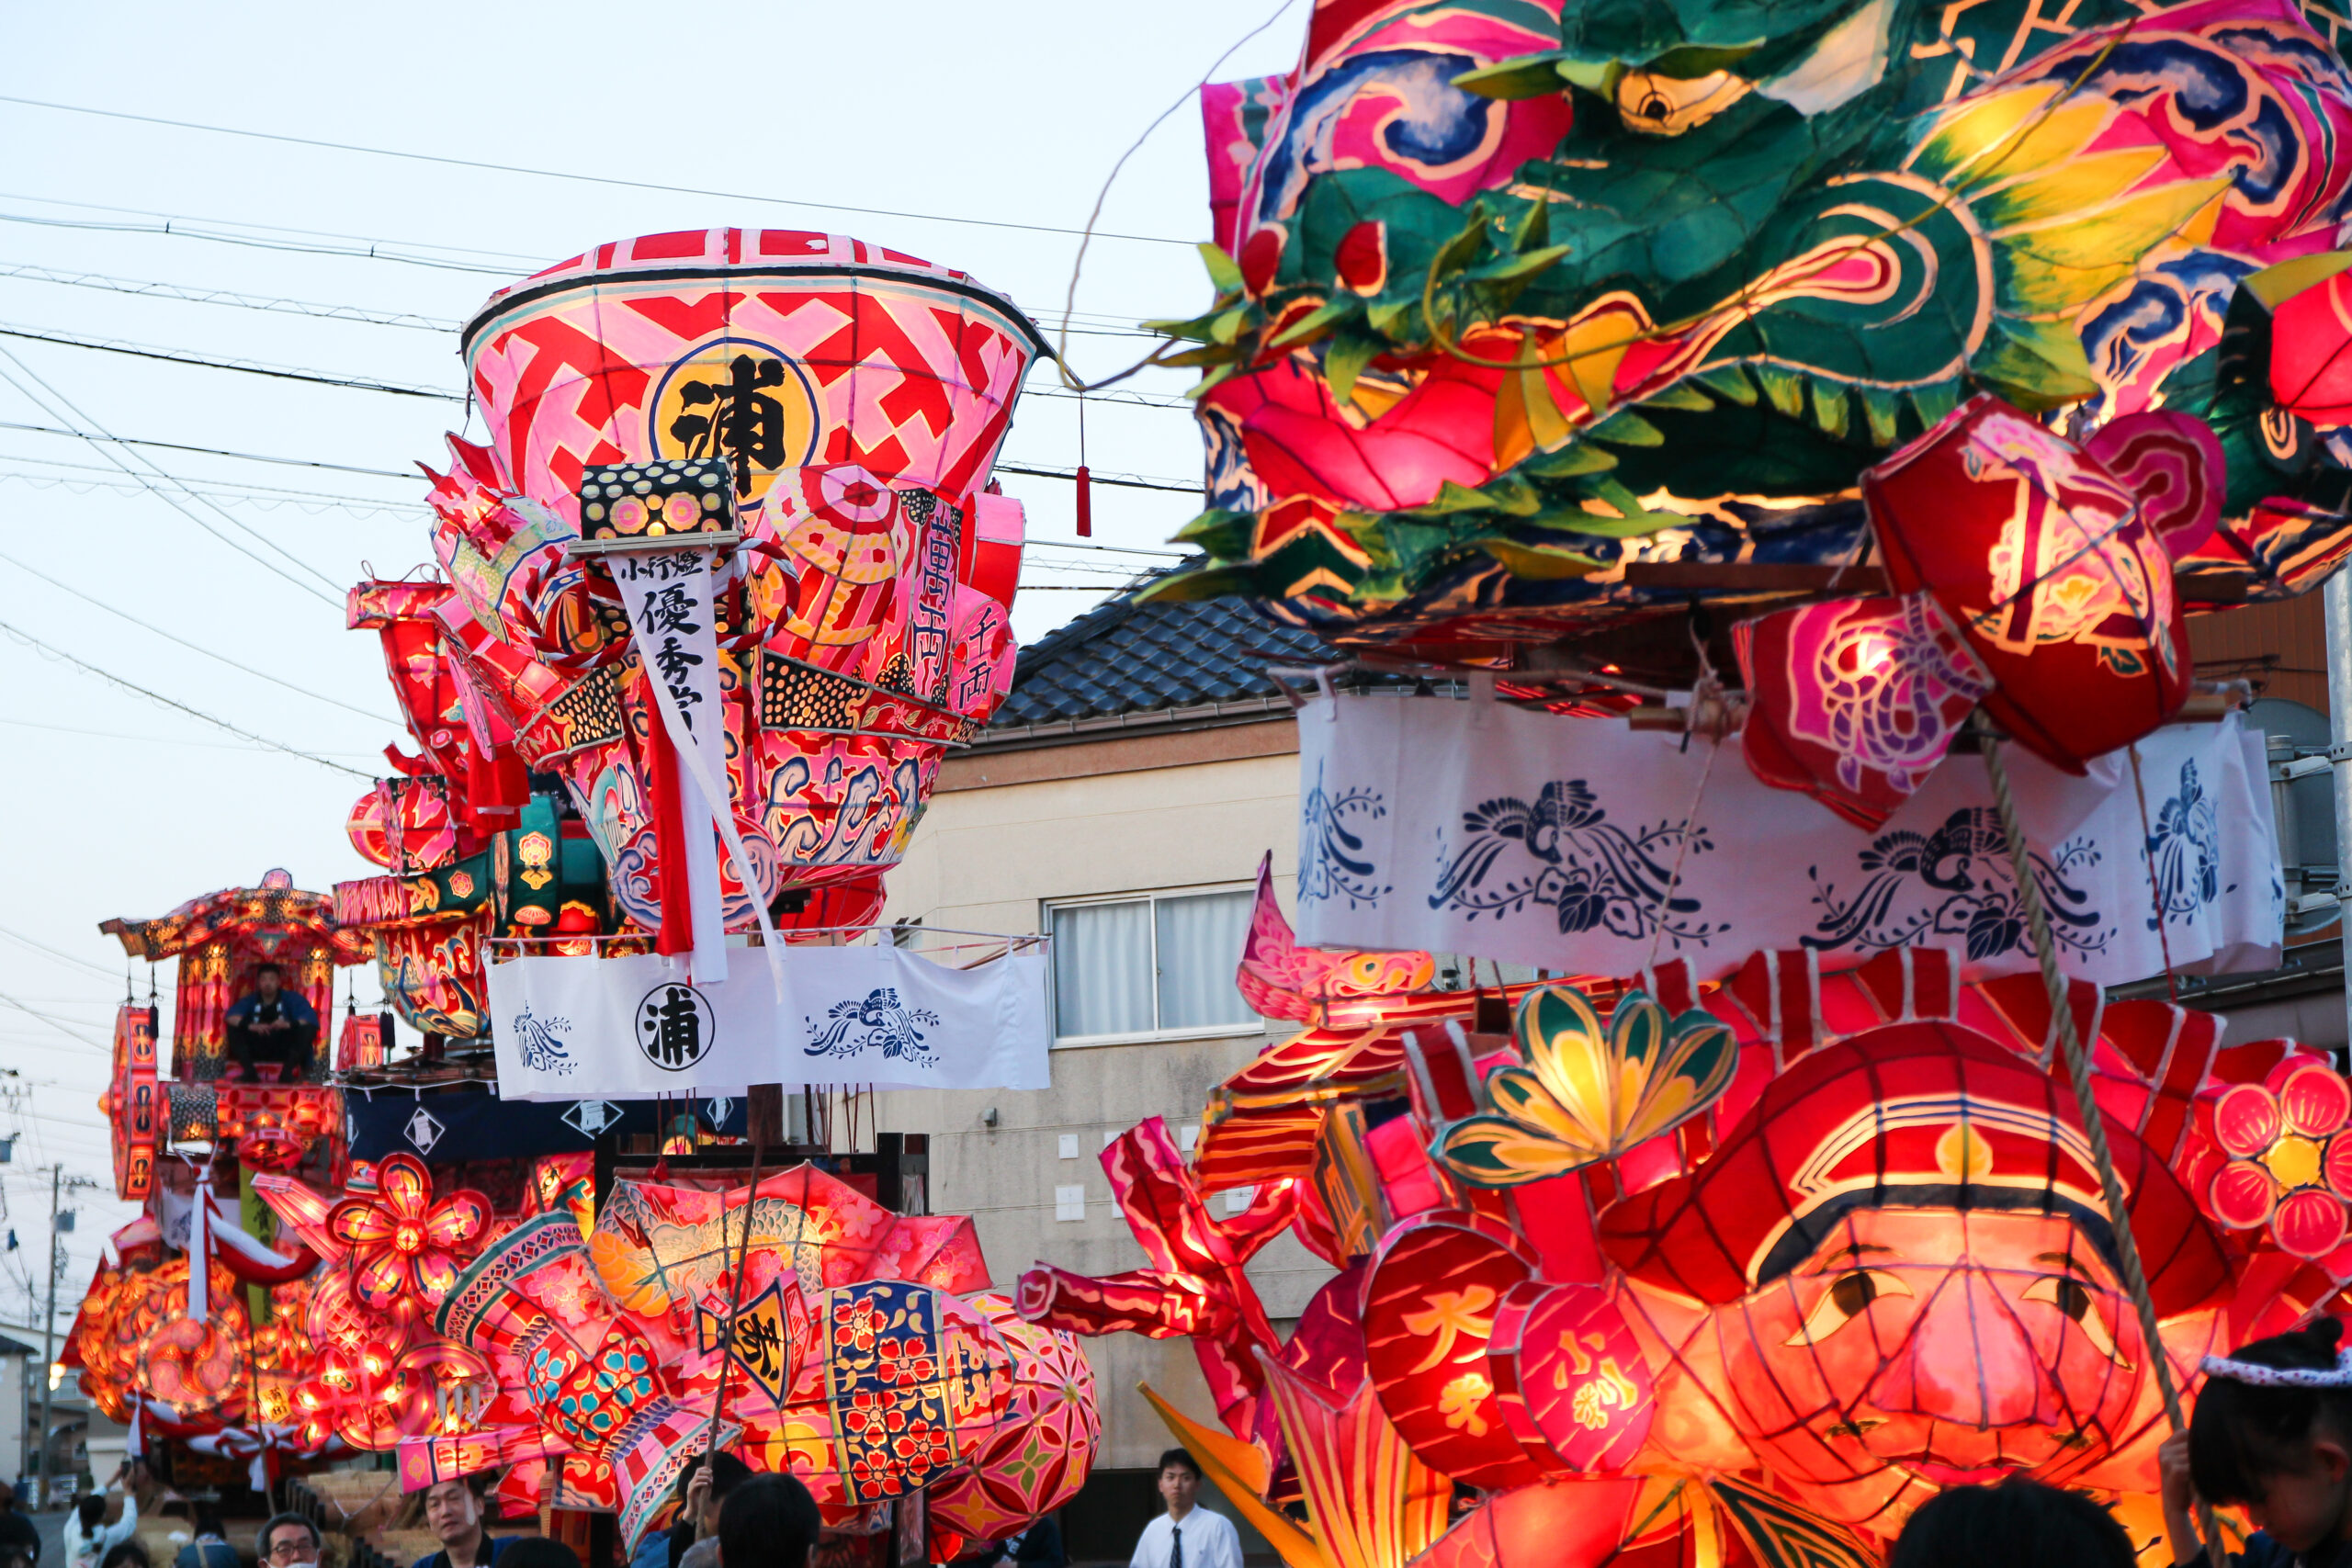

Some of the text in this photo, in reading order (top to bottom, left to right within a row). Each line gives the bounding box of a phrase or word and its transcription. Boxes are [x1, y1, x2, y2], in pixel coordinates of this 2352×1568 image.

[671, 354, 786, 498] 浦
[621, 552, 704, 581] 小行燈
[958, 606, 997, 709] 千両
[644, 987, 699, 1066] 浦
